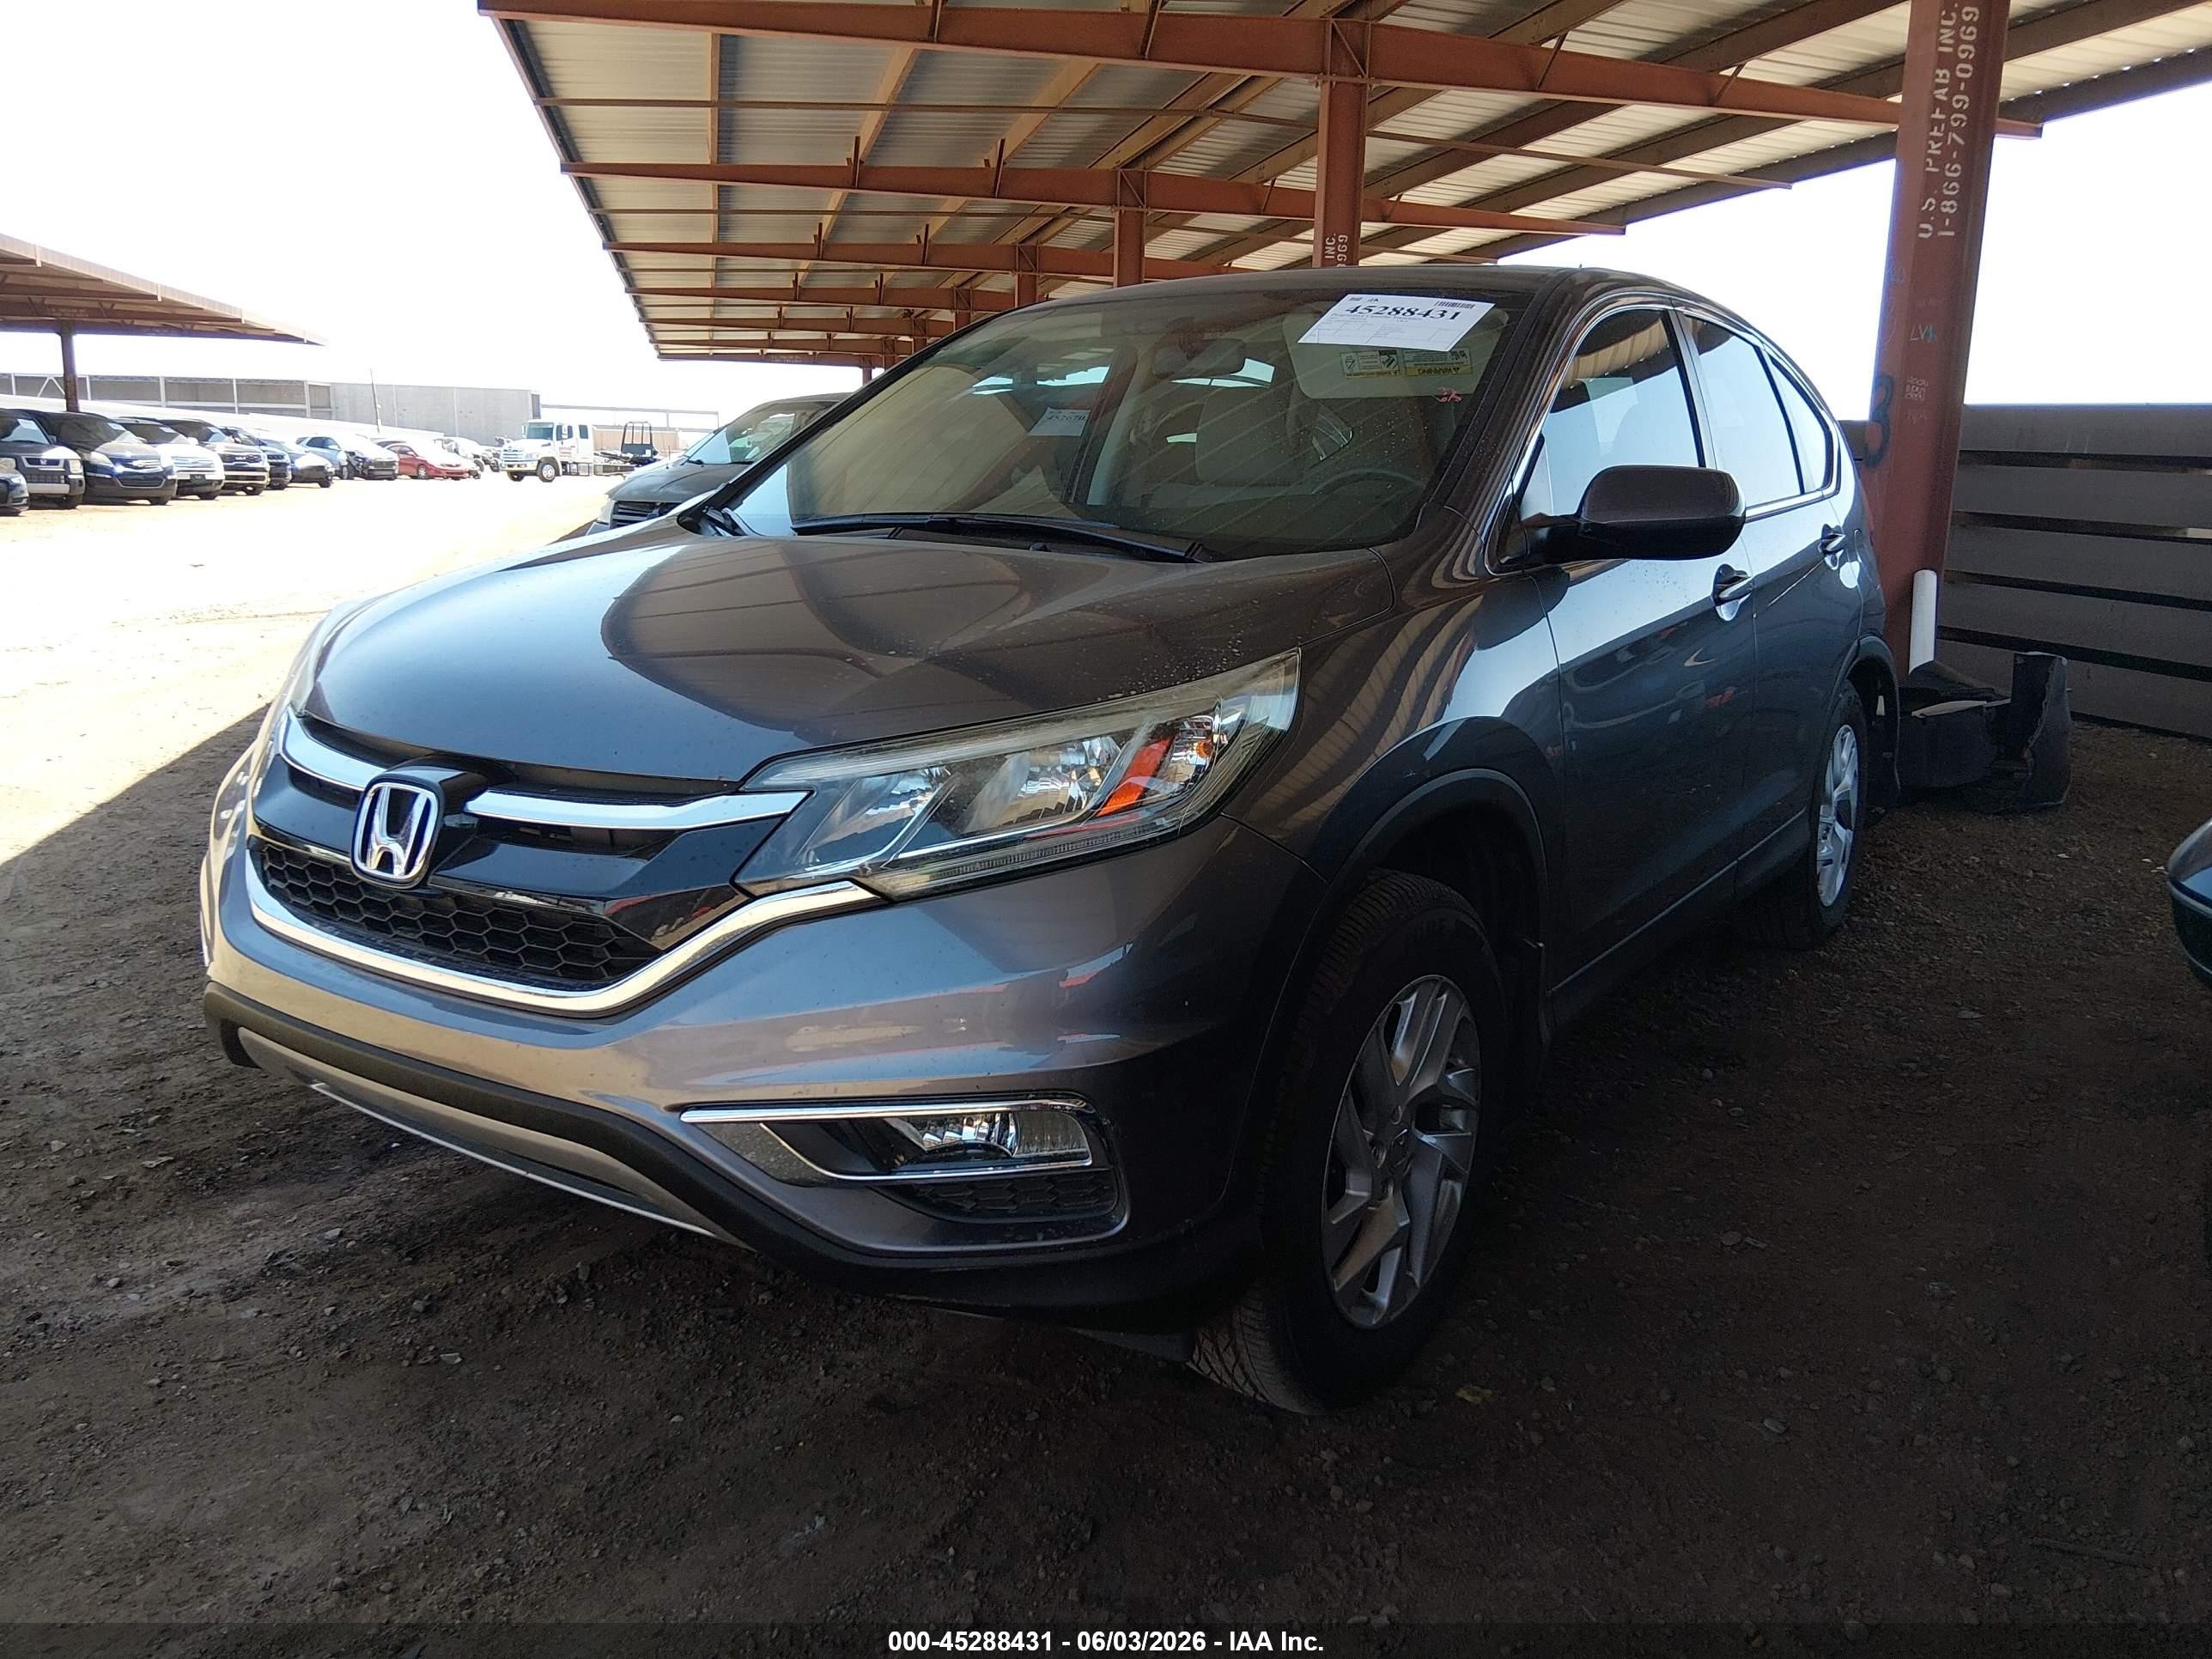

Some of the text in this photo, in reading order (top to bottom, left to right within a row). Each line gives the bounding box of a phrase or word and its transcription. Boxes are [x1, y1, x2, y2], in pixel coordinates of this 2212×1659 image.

[1924, 68, 1950, 173] PREFAB
[1937, 3, 1959, 53] INC.
[1937, 6, 1979, 237] 1-866-799-0969
[1324, 233, 1336, 259] INC.
[1345, 304, 1462, 321] 45288431
